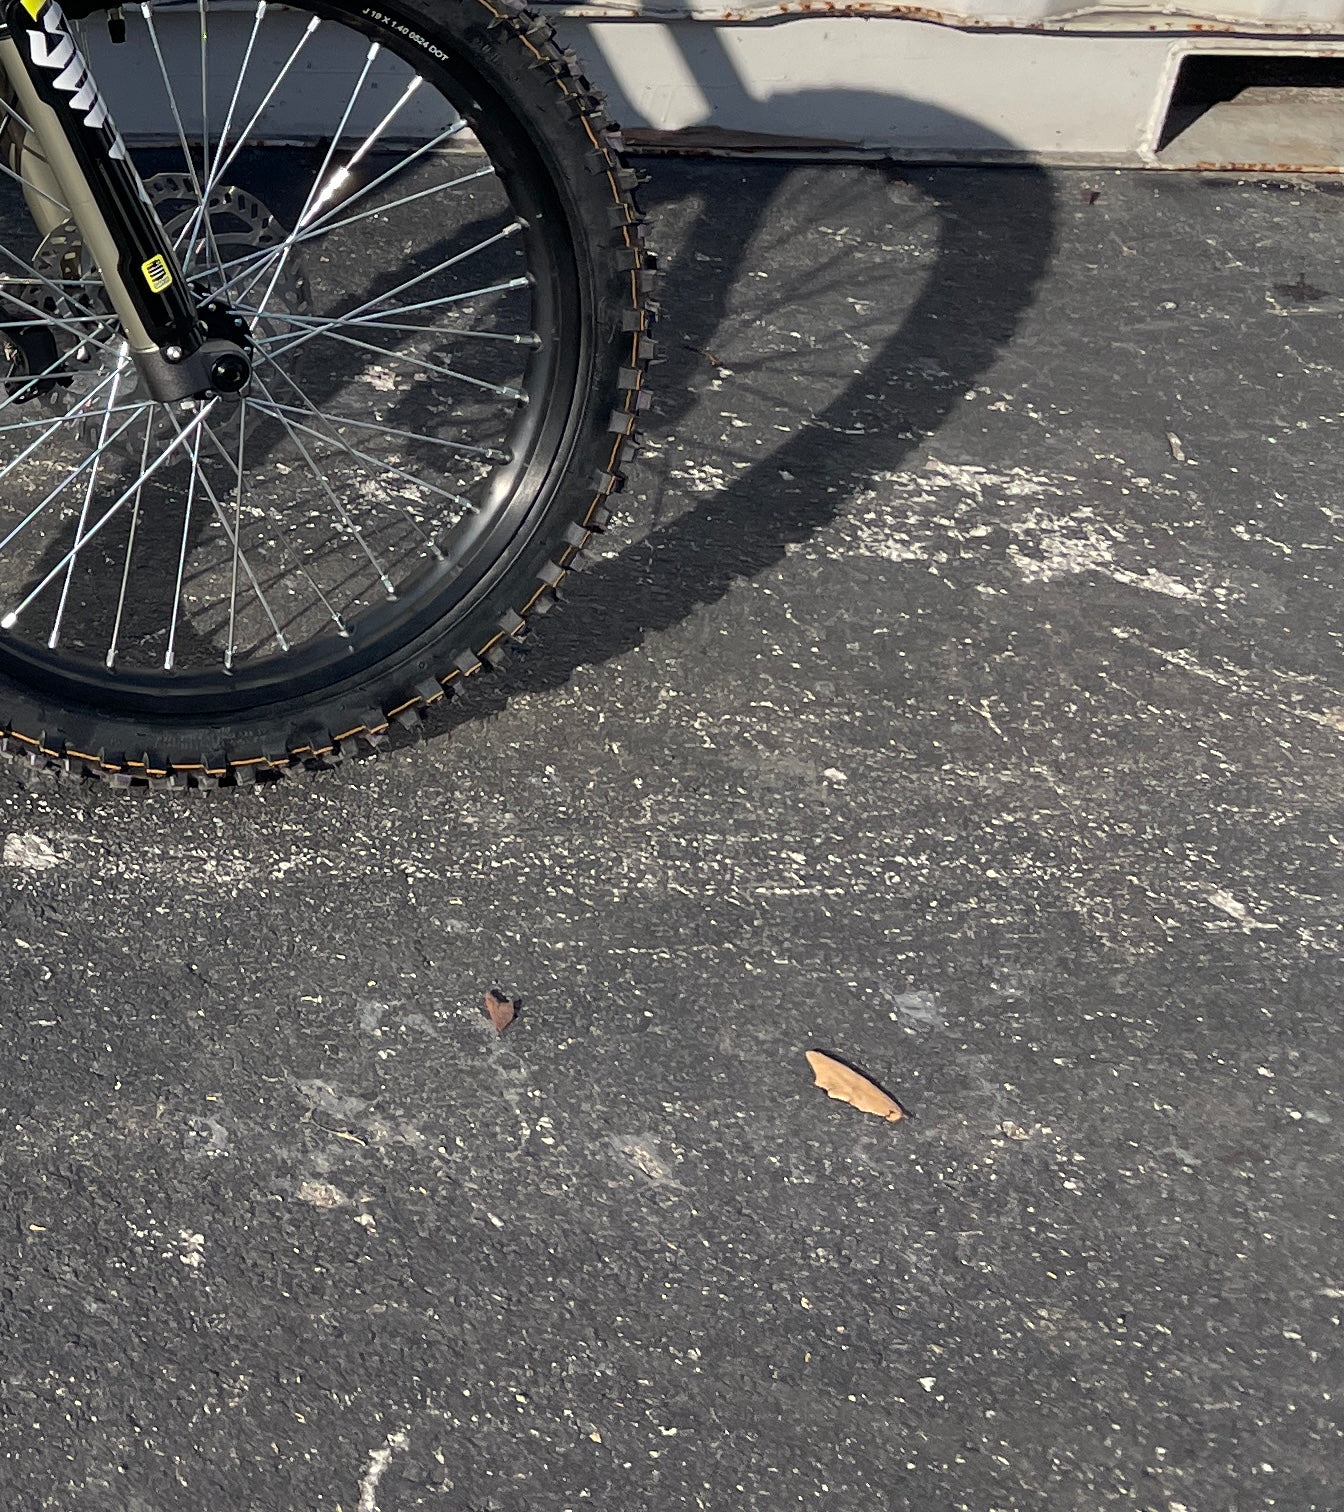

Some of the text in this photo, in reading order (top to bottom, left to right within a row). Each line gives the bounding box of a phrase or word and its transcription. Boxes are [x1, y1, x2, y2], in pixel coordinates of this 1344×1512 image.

[370, 9, 382, 20] 19
[381, 15, 391, 25] X
[391, 20, 410, 35] 1.40
[428, 44, 450, 61] DOT
